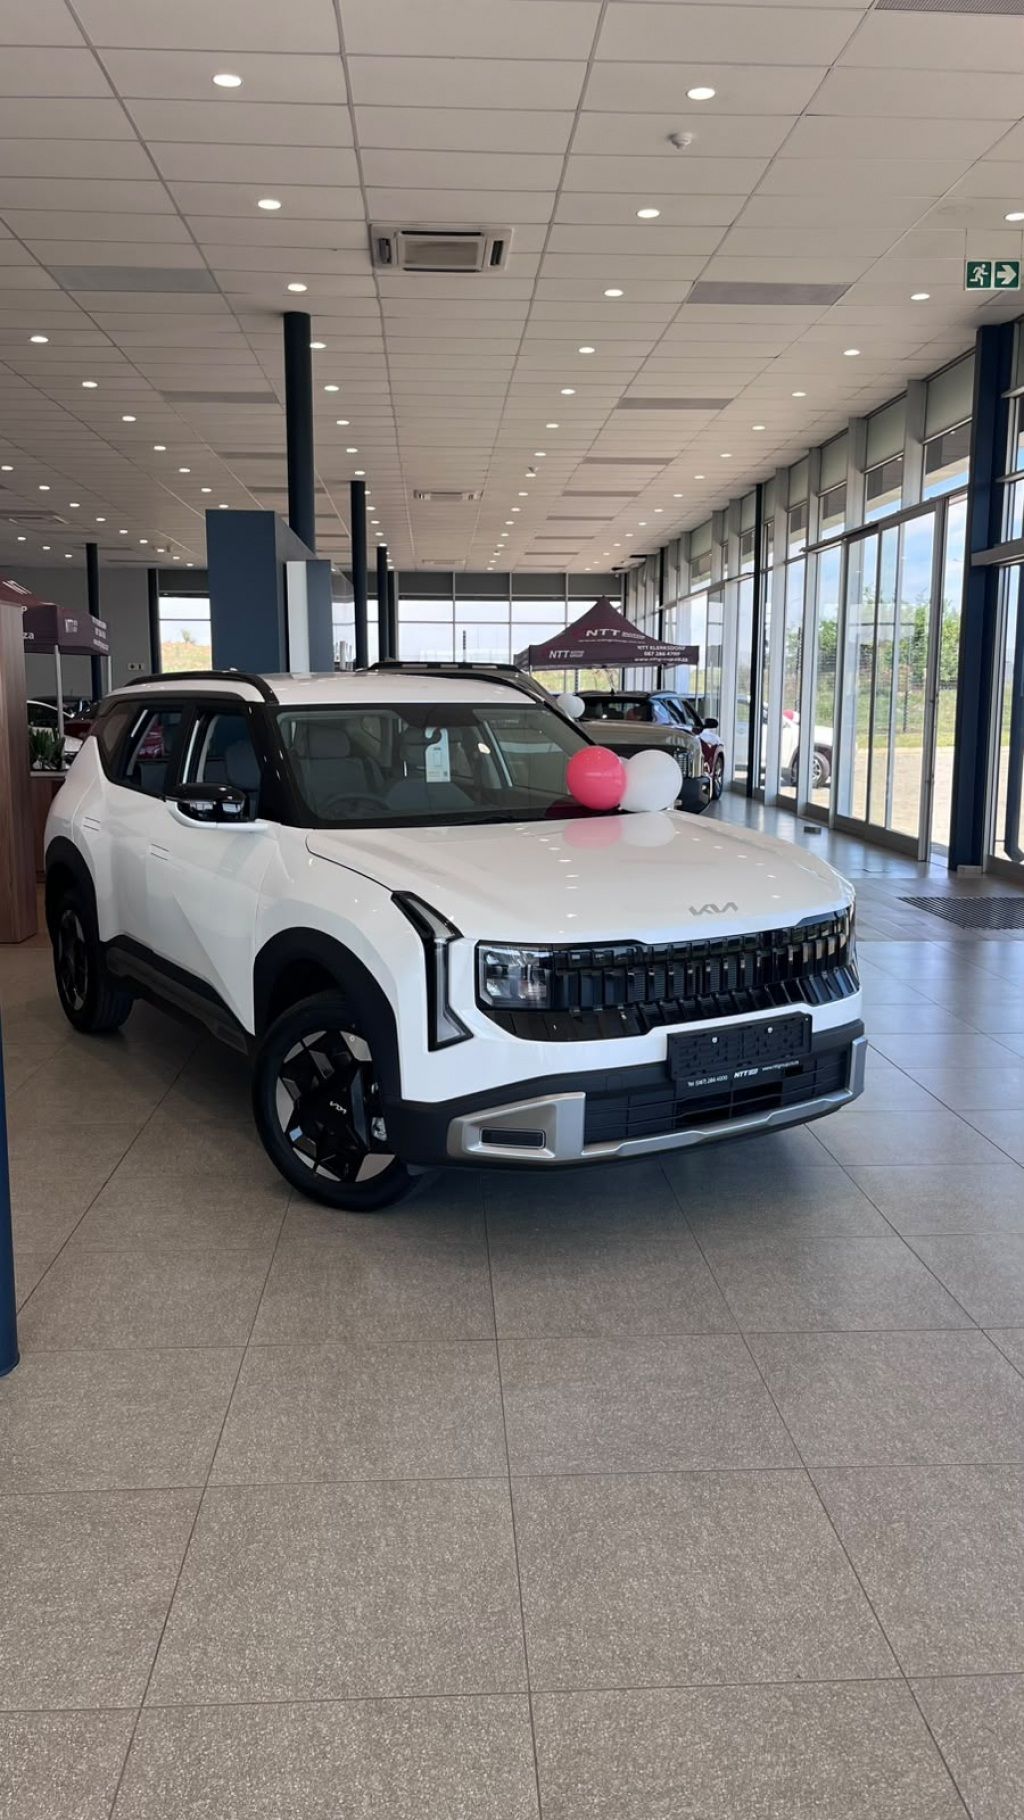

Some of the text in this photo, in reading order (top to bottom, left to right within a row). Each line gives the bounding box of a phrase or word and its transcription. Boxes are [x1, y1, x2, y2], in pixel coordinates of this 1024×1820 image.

[586, 628, 621, 637] NTT
[548, 650, 570, 659] NTT
[733, 1070, 747, 1079] NTT
